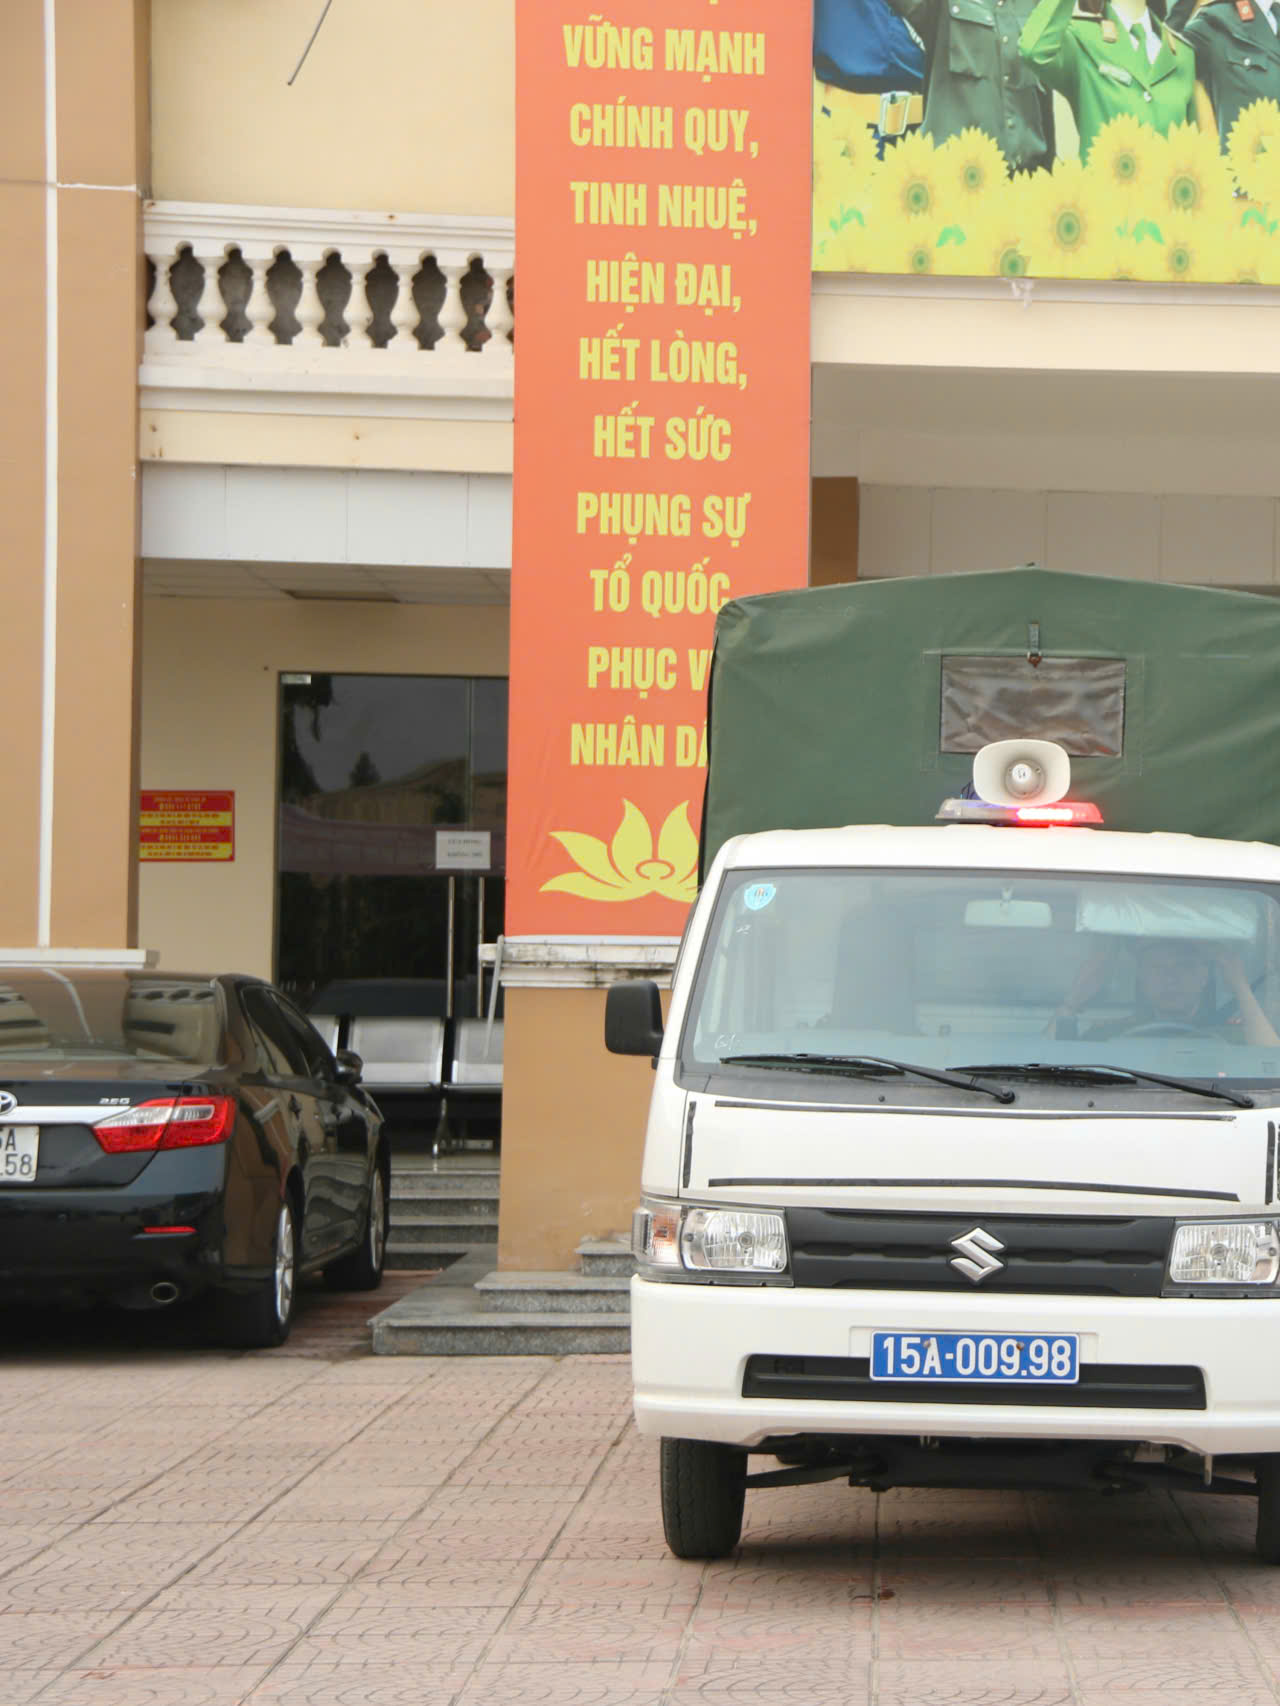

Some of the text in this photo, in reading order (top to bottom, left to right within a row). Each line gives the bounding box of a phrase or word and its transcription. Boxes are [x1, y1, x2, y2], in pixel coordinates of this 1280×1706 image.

[563, 14, 765, 83] VỮNG MẠNH
[570, 96, 759, 158] CHÍNH QUY,
[570, 179, 757, 240] TINH NHUỆ,
[586, 252, 741, 316] HIỆN ĐẠI,
[579, 323, 747, 390] HẾT LÒNG,
[594, 401, 732, 461] HẾT SỨC
[577, 492, 752, 547] PHỤNG SỰ
[590, 553, 731, 618] TỔ QUỐC
[588, 646, 714, 699] PHỤC V
[571, 715, 665, 767] NHÂN
[883, 1337, 1071, 1377] 15A-009.98
